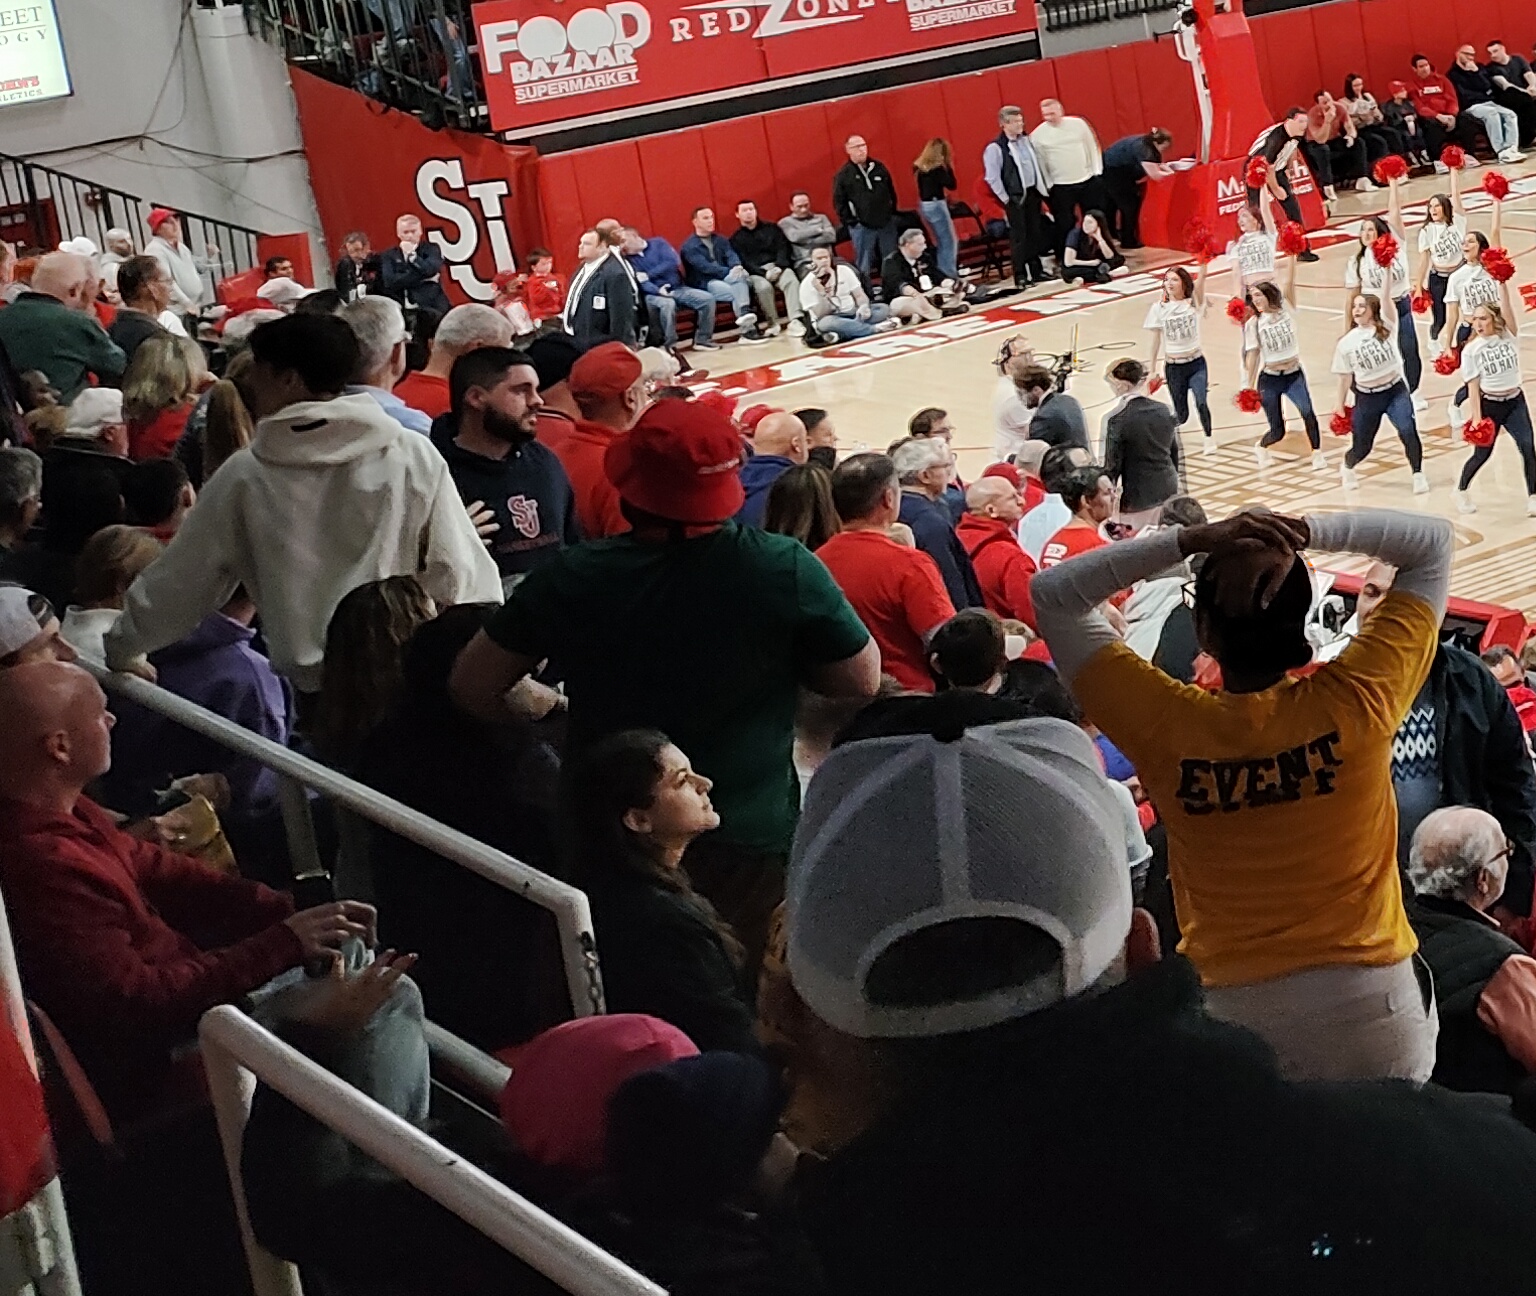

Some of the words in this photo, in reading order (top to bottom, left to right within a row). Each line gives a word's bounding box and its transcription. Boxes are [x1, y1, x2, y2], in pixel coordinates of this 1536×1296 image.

[909, 0, 1017, 31] SUPERMARKET
[480, 1, 652, 73] FOOD
[510, 42, 636, 84] BAZAAR
[515, 67, 640, 102] SUPERMARKET
[1175, 732, 1344, 804] EVENT
